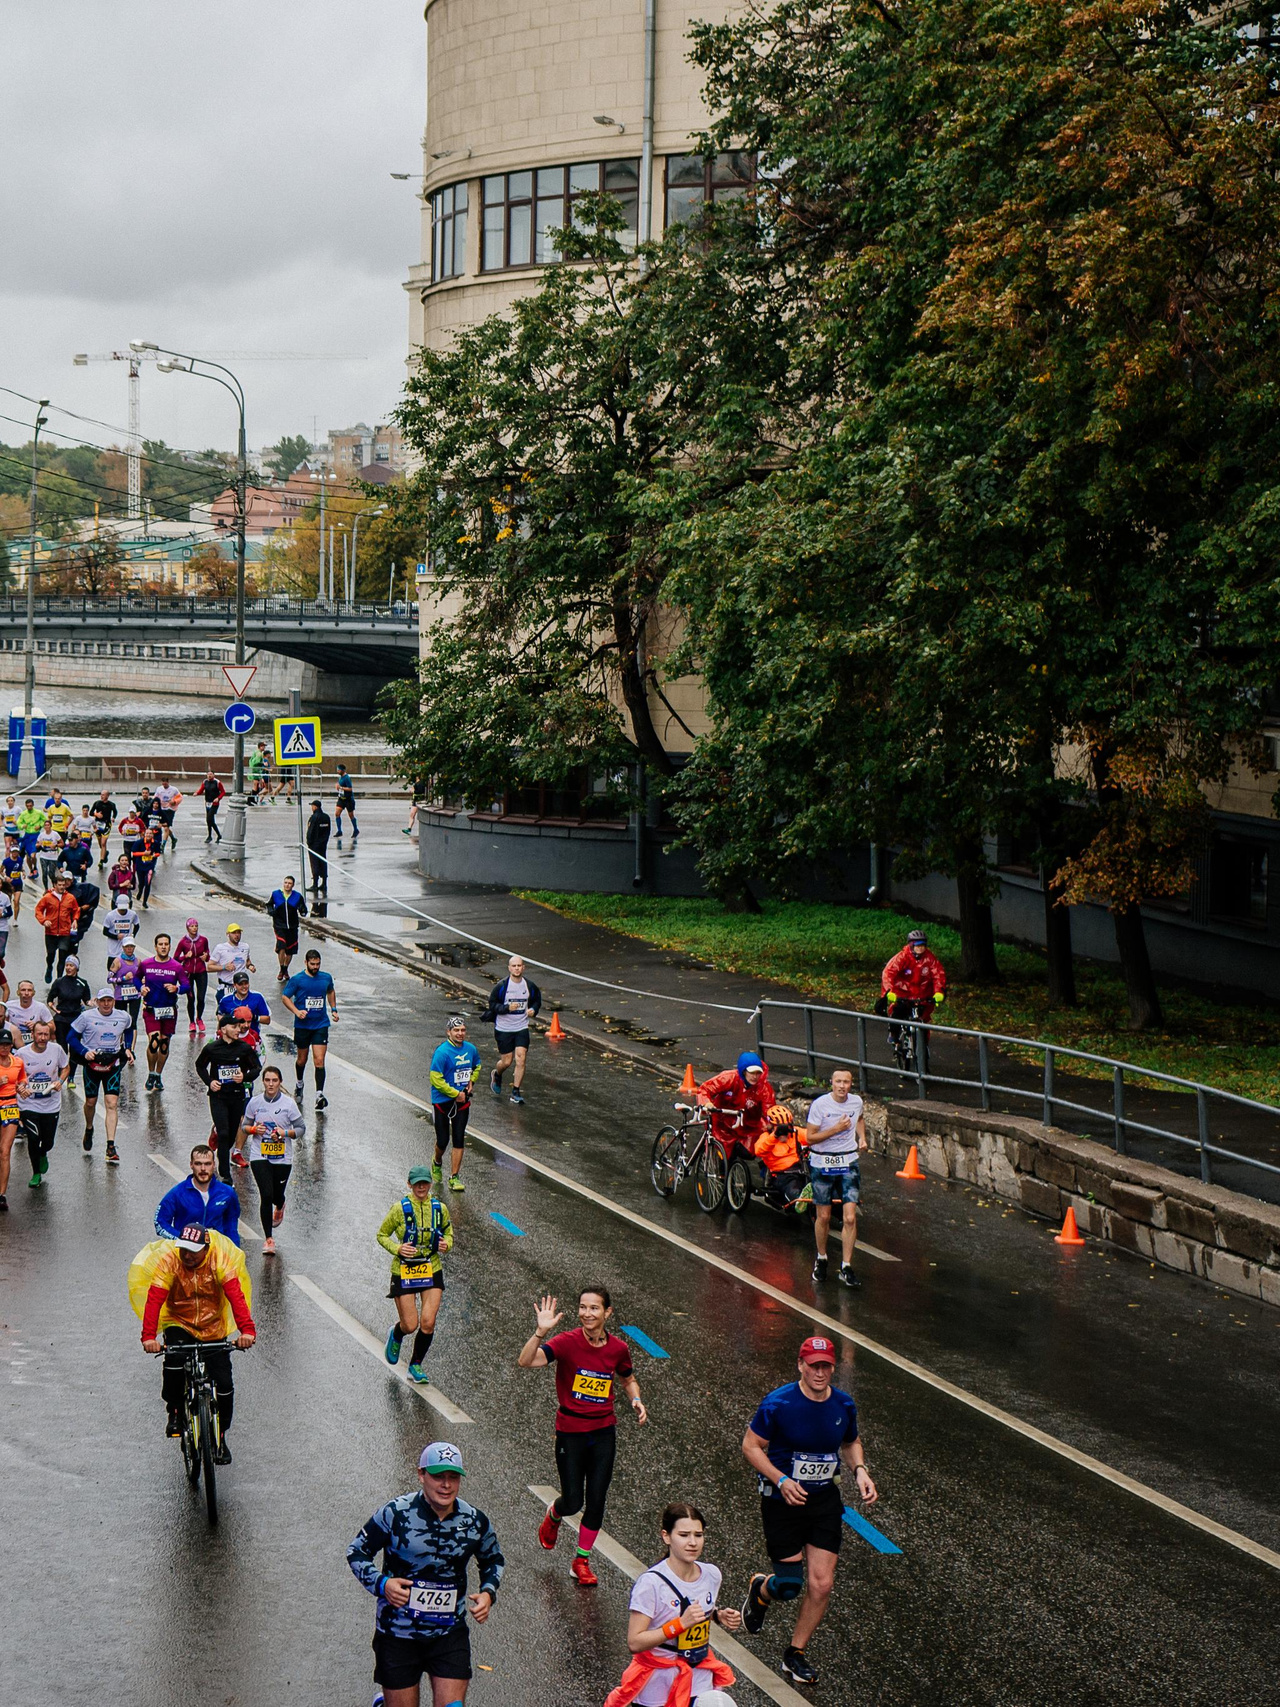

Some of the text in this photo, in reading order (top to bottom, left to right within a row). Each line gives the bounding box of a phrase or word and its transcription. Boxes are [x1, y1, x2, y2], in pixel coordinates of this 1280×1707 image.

[146, 967, 162, 975] WAKE
[31, 1082, 49, 1090] 6917
[264, 1144, 282, 1152] 7085
[824, 1156, 845, 1164] 8681
[404, 1264, 428, 1275] 3542
[579, 1377, 607, 1392] 2425
[799, 1463, 830, 1475] 6376
[416, 1591, 452, 1606] 4762
[685, 1623, 709, 1642] 421
